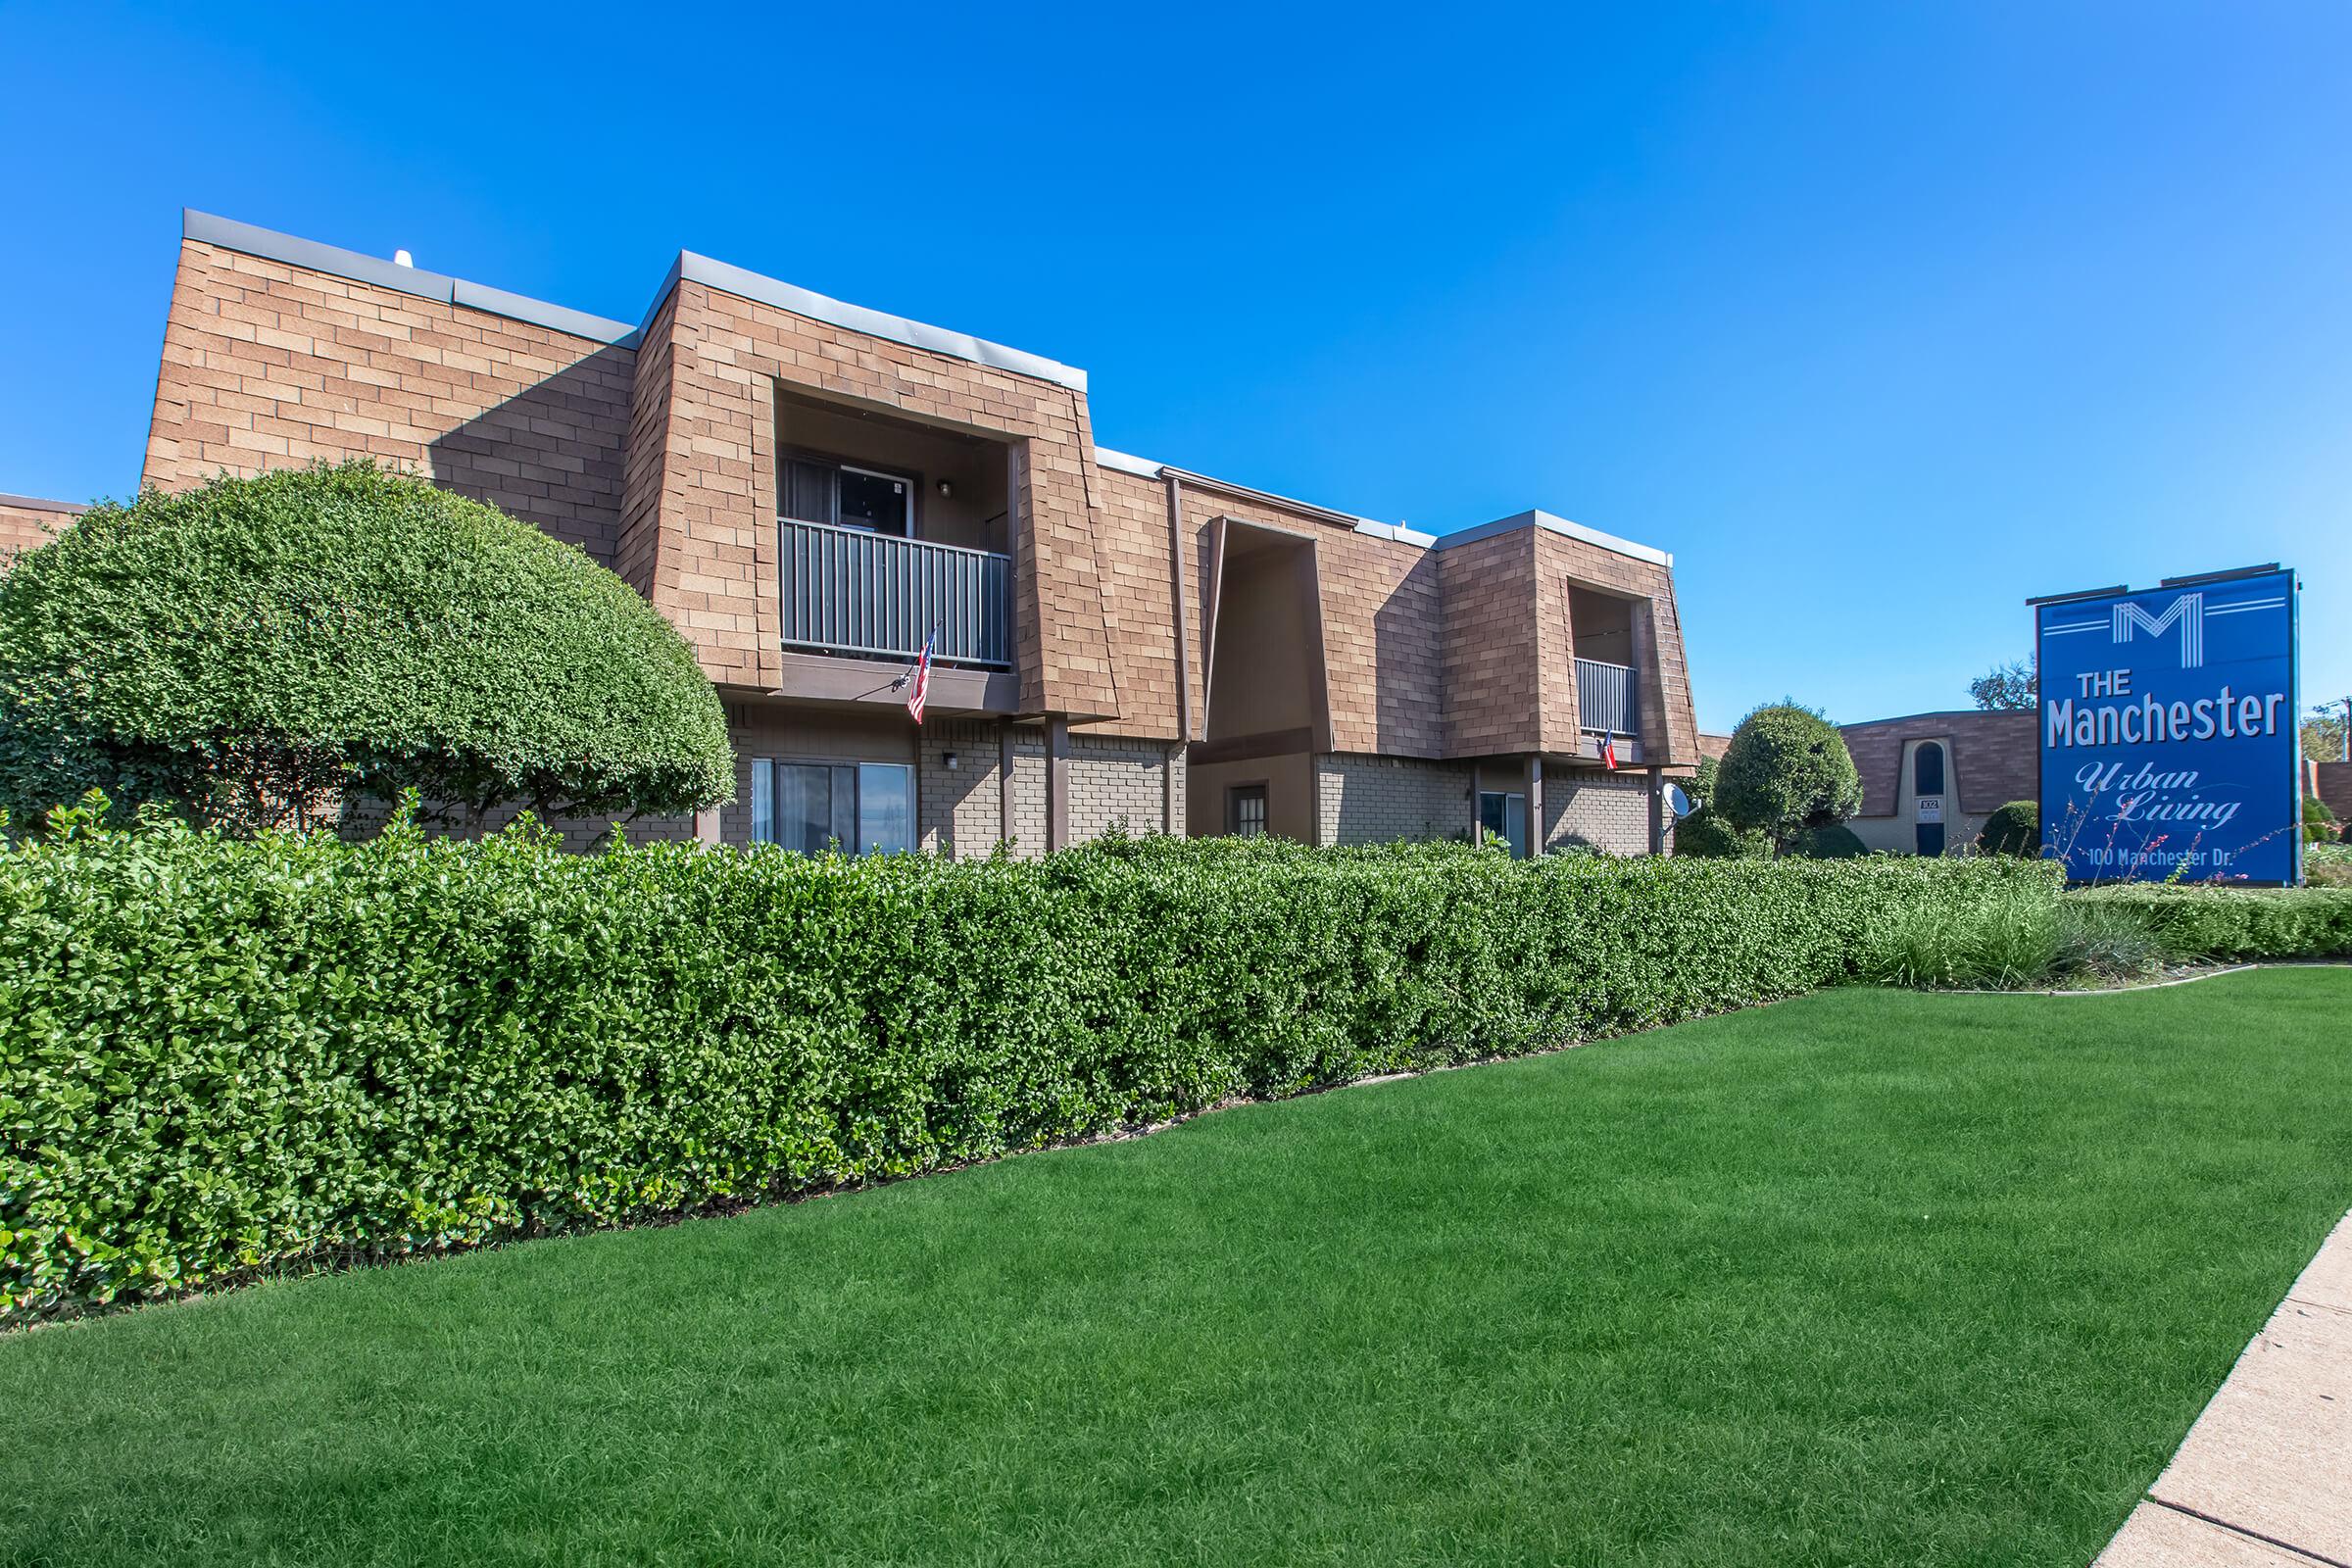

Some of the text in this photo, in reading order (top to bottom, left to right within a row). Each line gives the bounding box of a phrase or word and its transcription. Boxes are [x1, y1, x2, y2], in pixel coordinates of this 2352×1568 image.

[2077, 669, 2132, 698] THE
[2047, 686, 2284, 748] Manchester
[2075, 761, 2199, 793] Urban
[2105, 791, 2241, 830] Living
[2089, 847, 2233, 866] 100 Manchester Dr.
